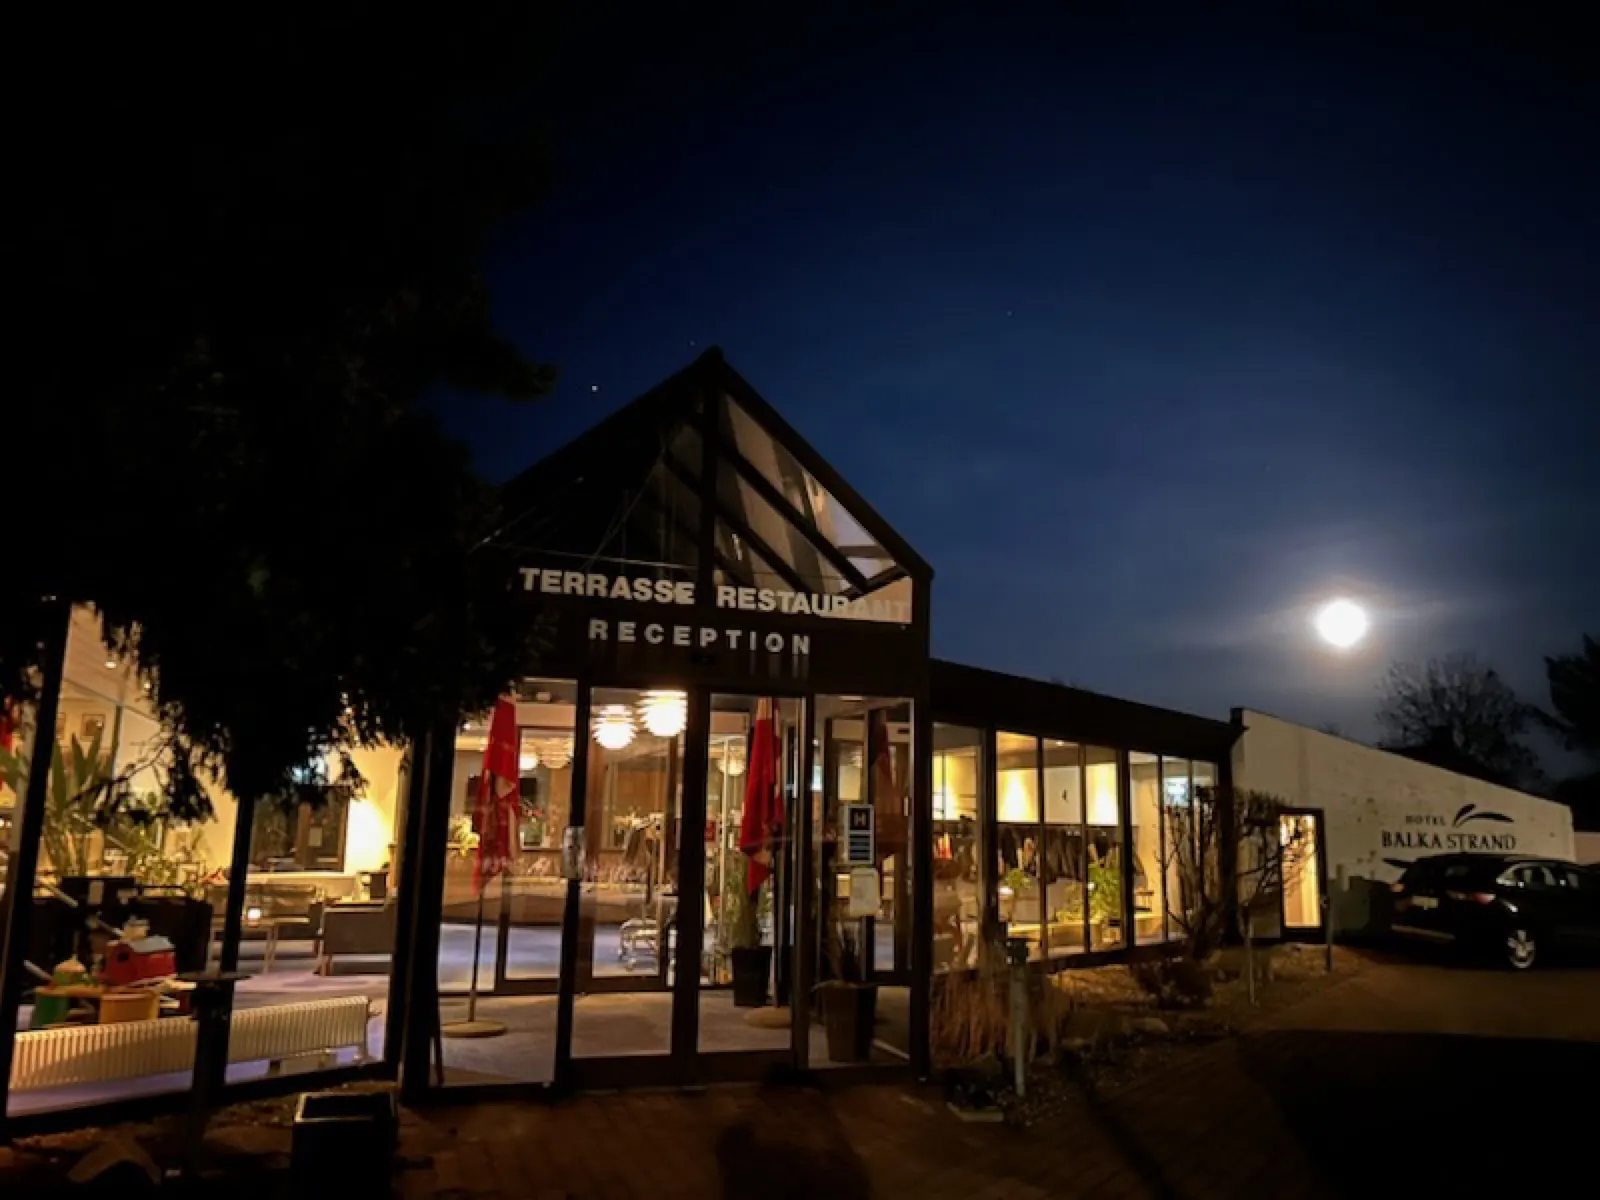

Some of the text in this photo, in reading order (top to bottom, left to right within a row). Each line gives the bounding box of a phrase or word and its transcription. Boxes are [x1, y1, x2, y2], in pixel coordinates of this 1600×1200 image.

[519, 567, 696, 606] TERRASSE
[588, 618, 812, 656] RECEPTION
[1405, 815, 1446, 826] HOTEL
[1381, 830, 1517, 850] BALKA STRAND
